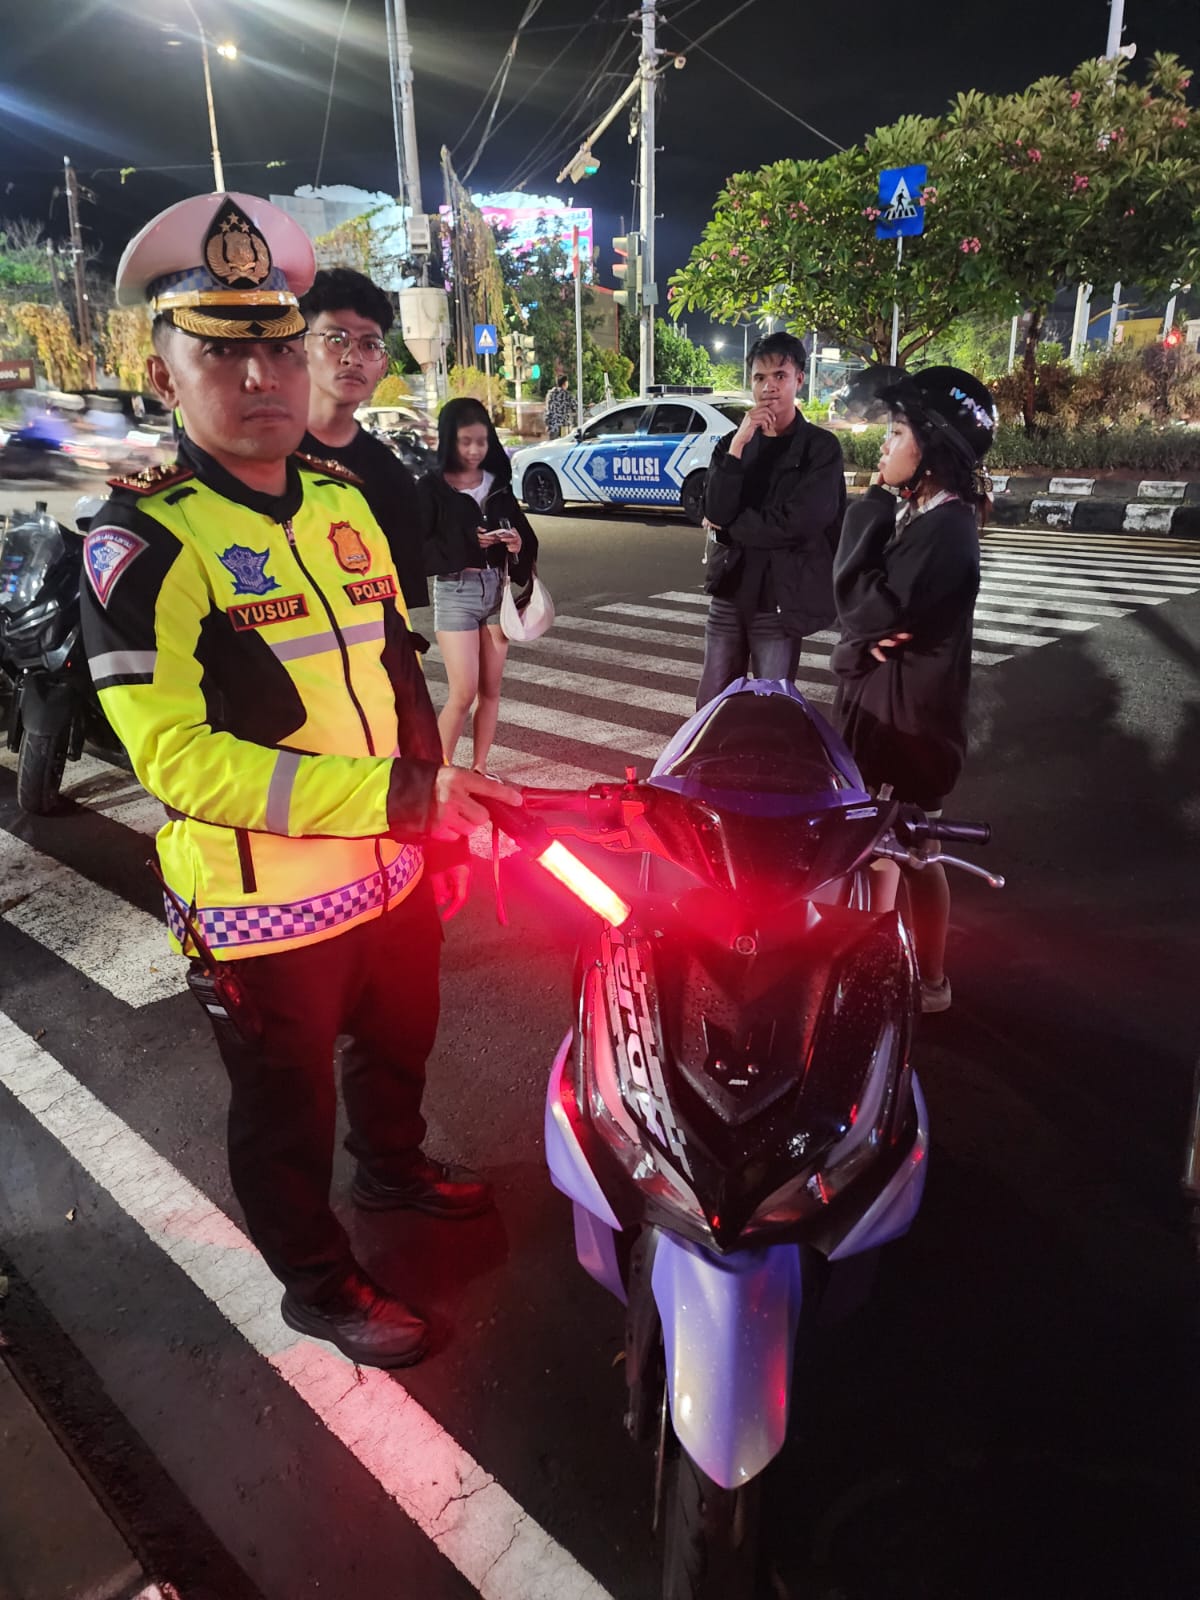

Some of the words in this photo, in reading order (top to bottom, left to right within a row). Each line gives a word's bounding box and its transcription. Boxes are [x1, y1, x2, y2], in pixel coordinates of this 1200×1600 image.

[613, 457, 660, 475] POLISI
[351, 579, 392, 601] POLRI
[237, 599, 299, 625] YUSUF
